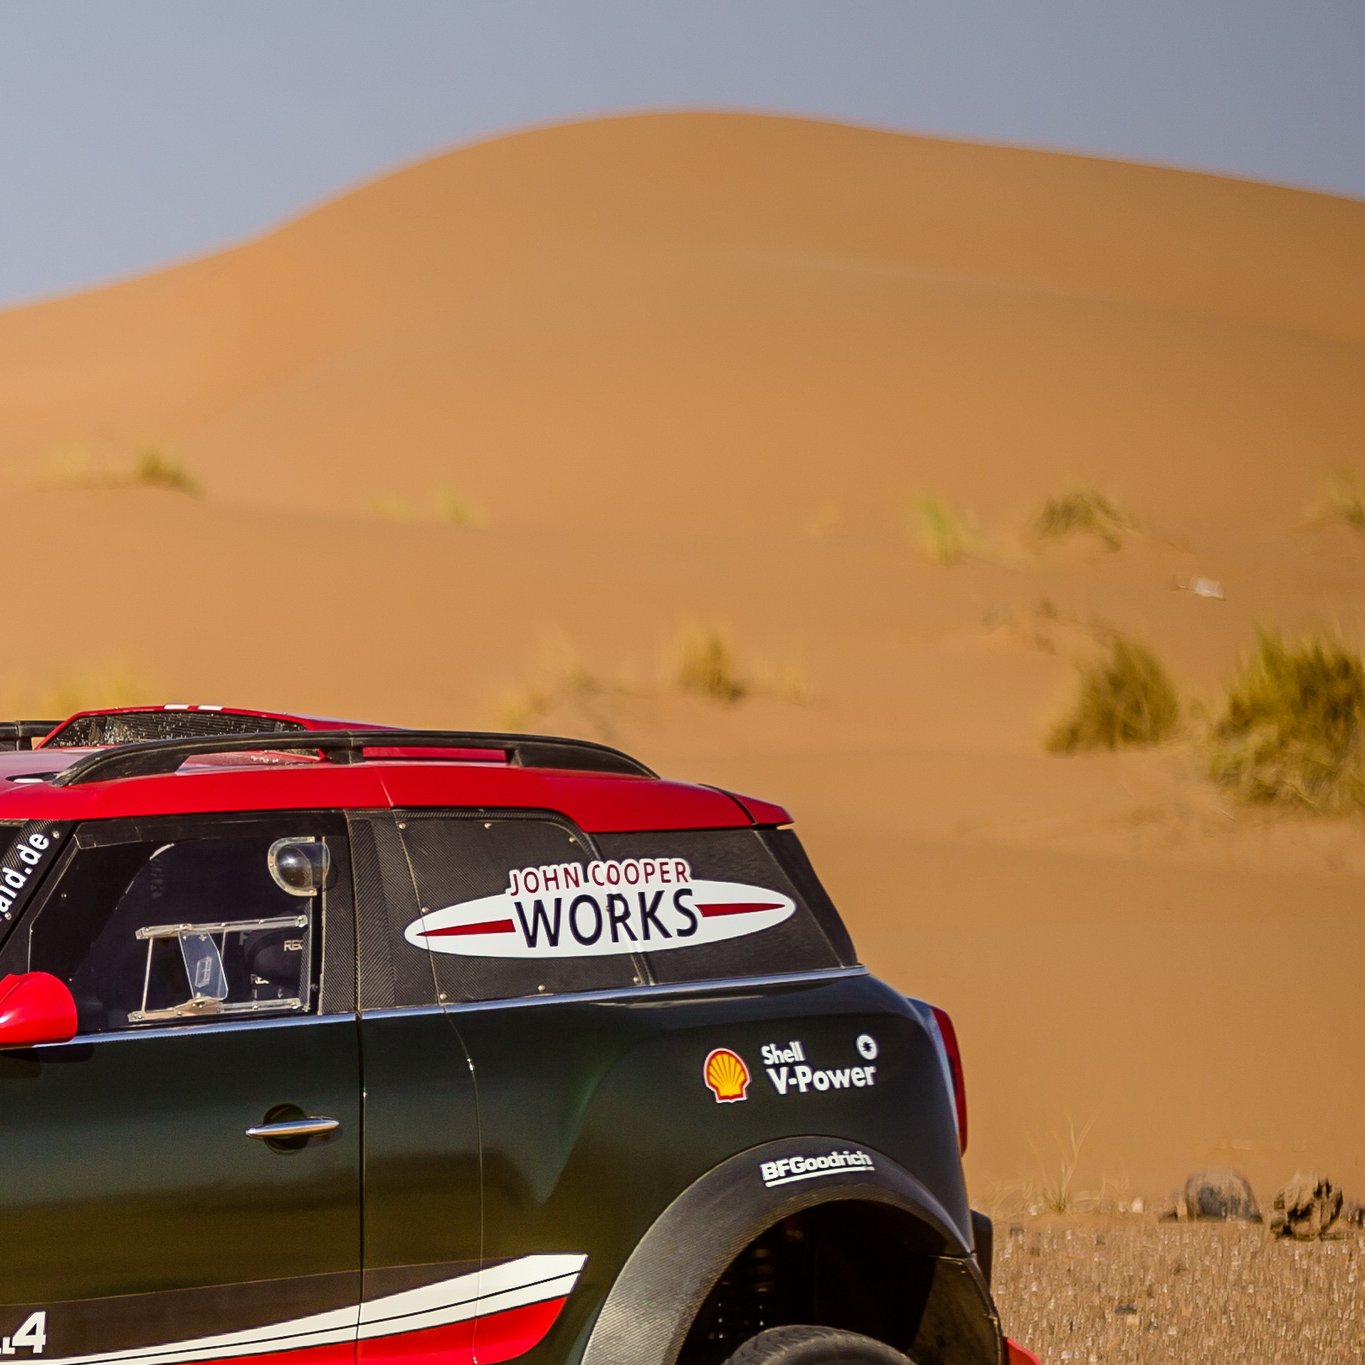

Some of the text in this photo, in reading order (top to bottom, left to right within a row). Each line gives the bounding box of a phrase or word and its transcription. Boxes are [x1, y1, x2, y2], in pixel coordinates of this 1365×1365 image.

[510, 861, 689, 896] JOHN COOPER
[514, 888, 698, 948] WORKS
[761, 1041, 806, 1065] Shell
[766, 1065, 876, 1095] V-Power
[760, 1150, 873, 1181] BFGoodrich
